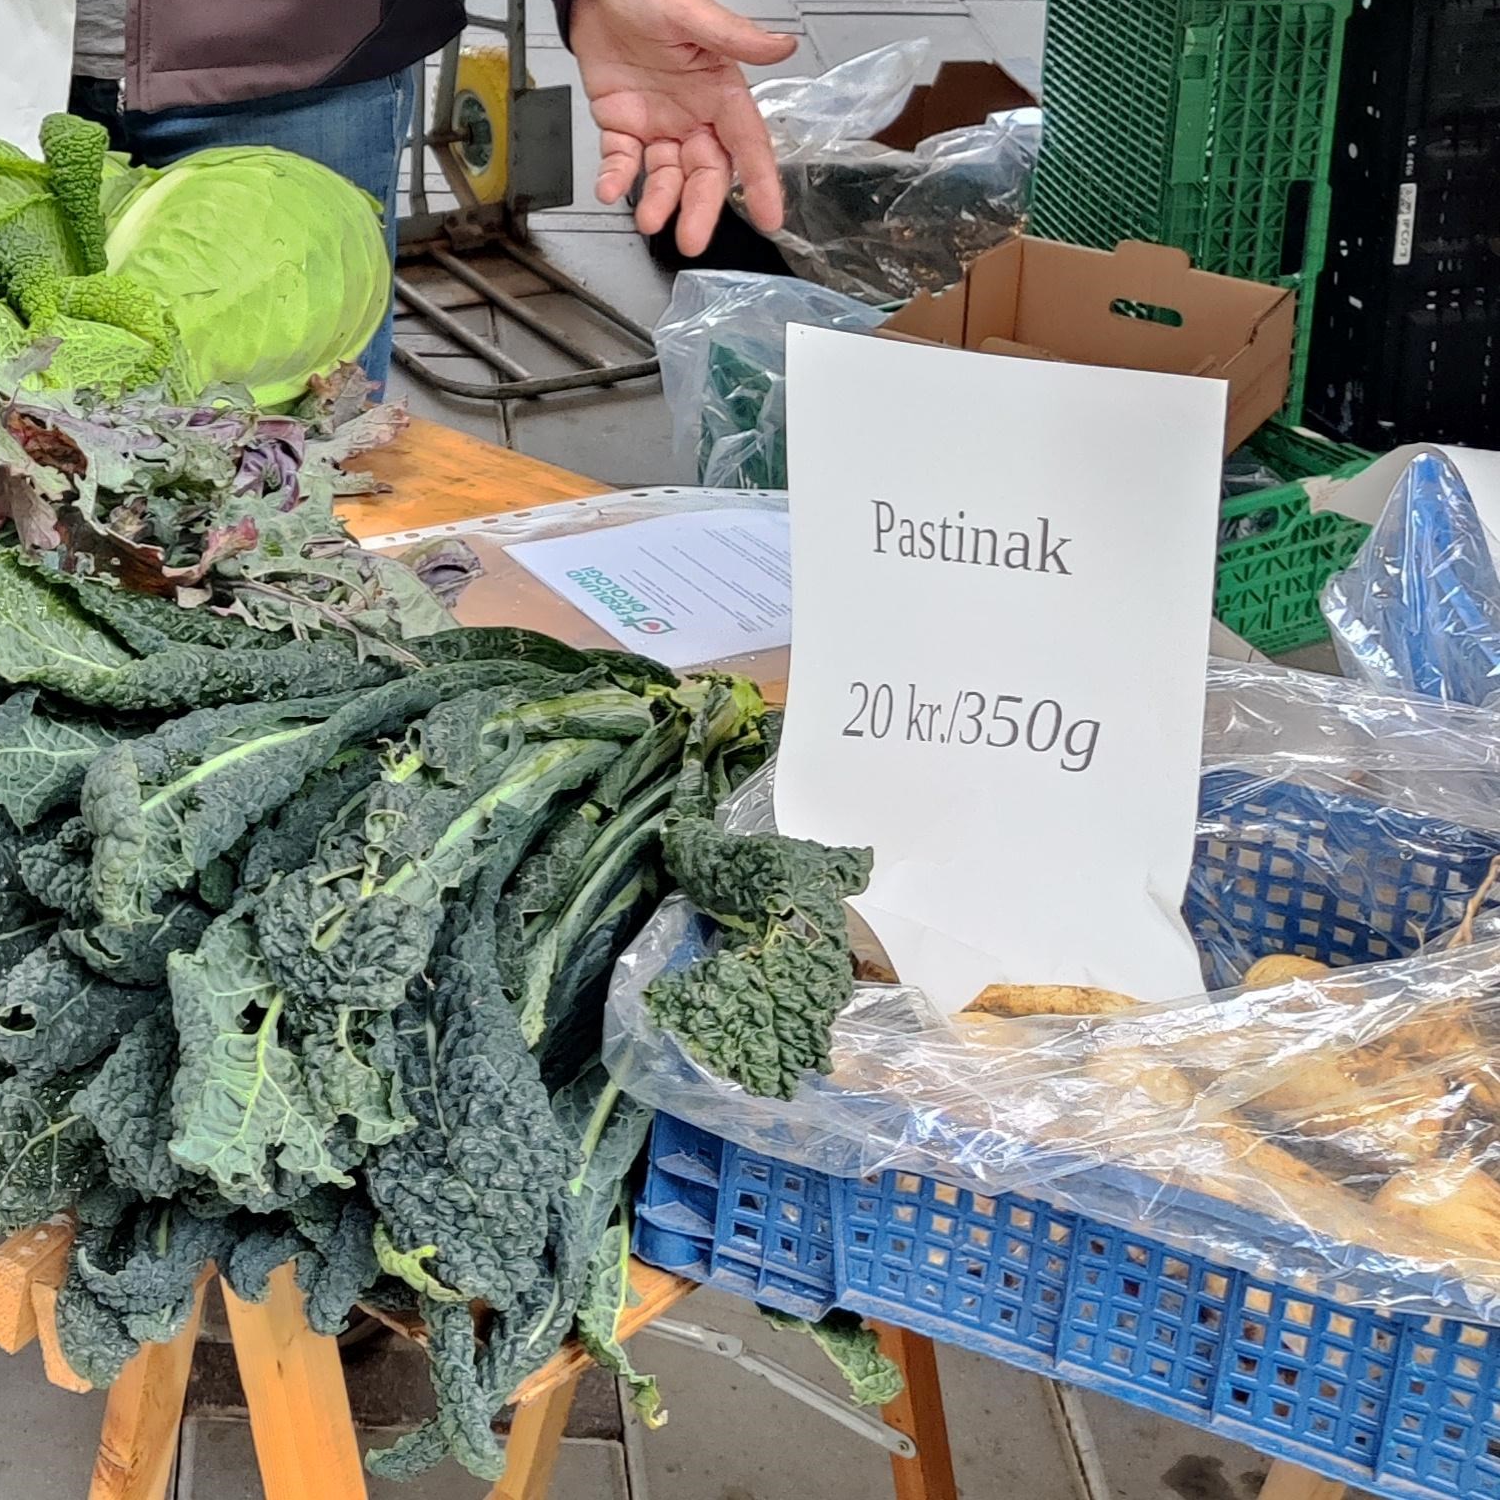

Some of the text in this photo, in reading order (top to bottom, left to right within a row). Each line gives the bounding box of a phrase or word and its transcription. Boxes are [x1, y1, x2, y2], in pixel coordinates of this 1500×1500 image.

[870, 499, 1073, 576] Pastinak
[565, 570, 635, 615] FRØLUND
[580, 566, 651, 612] ØKOLOGI
[842, 681, 1101, 773] 20 kr./350g
